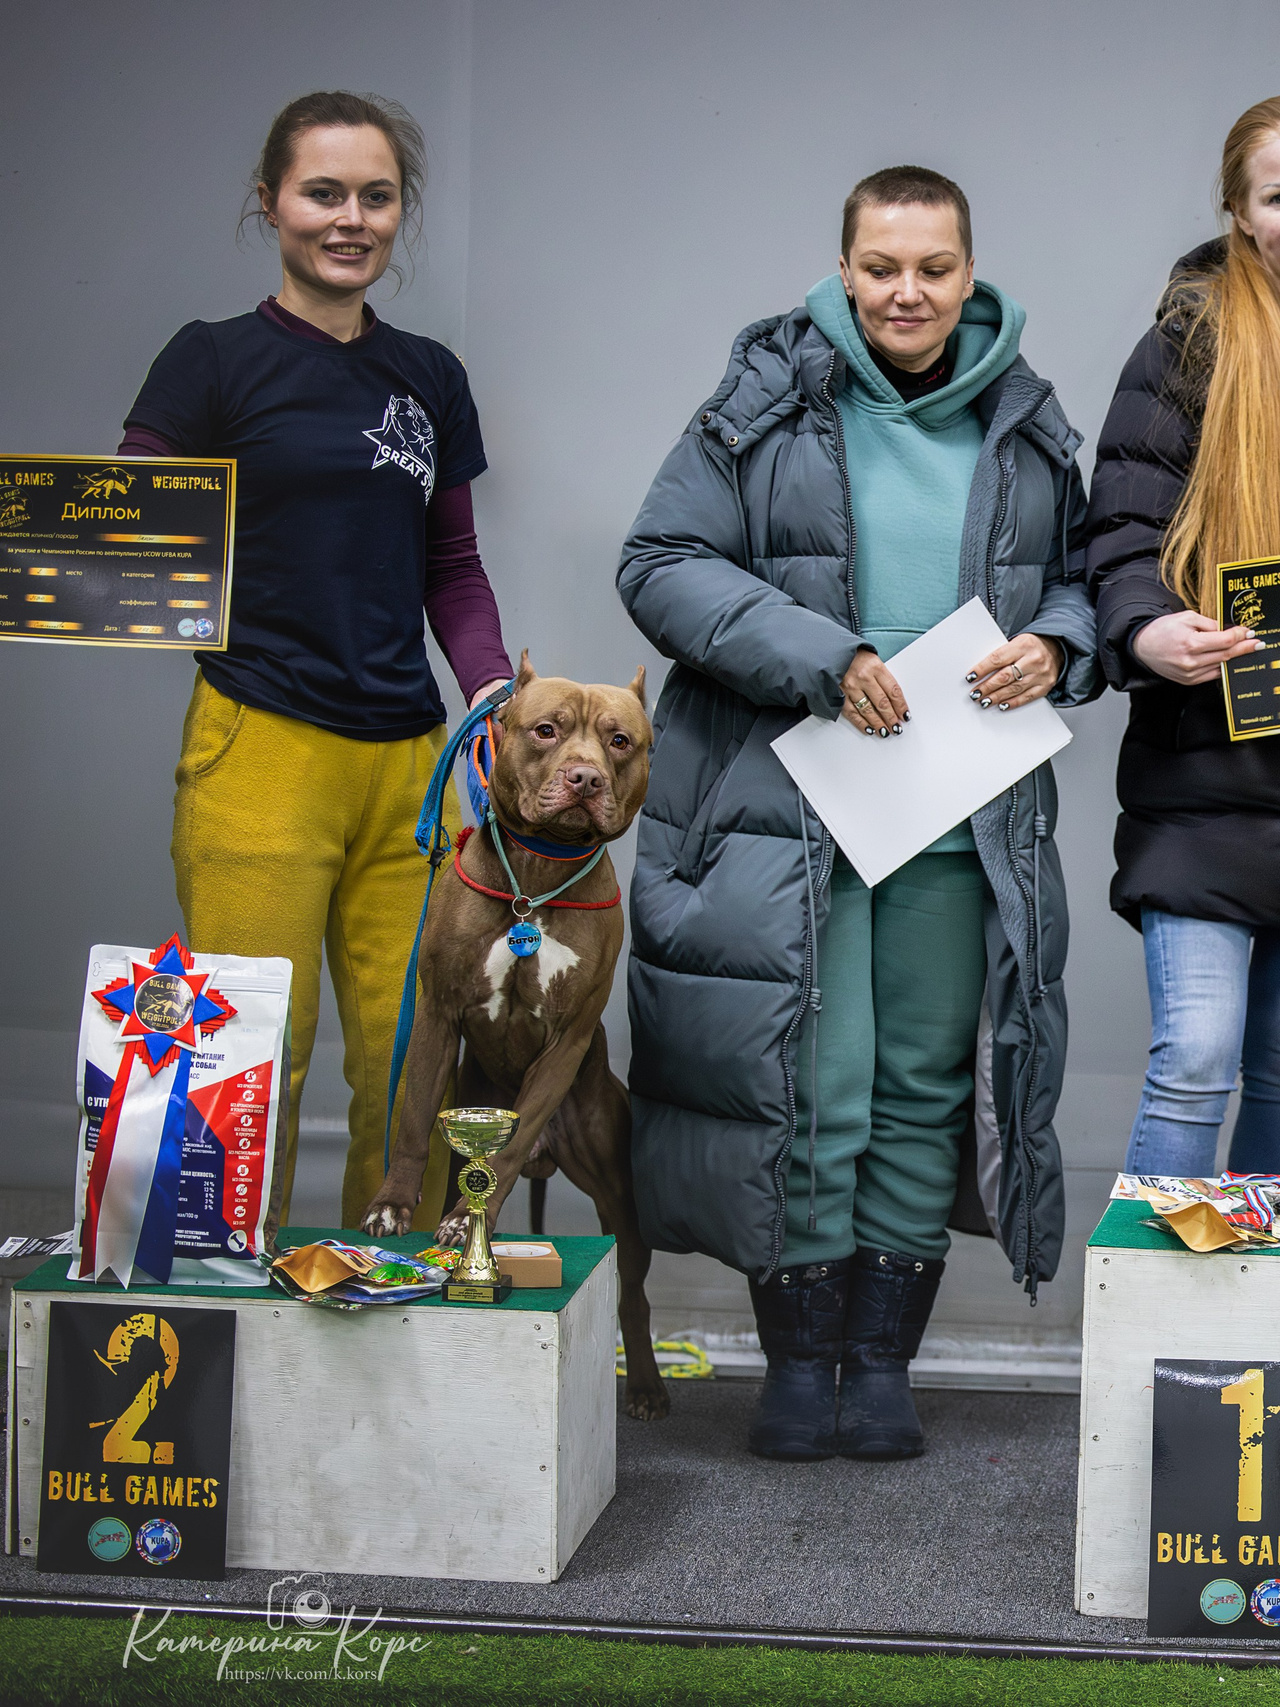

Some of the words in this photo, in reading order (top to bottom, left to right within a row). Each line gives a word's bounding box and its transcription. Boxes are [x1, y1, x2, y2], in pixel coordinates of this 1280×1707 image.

[380, 444, 423, 478] GREAT
[15, 472, 55, 486] GAMES
[152, 475, 222, 490] WEIGHTPULL
[61, 502, 141, 521] Диплом
[1228, 577, 1251, 592] BULL
[508, 934, 540, 945] Батон
[149, 979, 164, 988] BULL
[166, 981, 180, 990] GAM
[195, 1060, 217, 1070] СОБАК
[87, 1096, 93, 1107] С
[1221, 1368, 1265, 1522] 1
[48, 1470, 115, 1503] BULL
[125, 1474, 220, 1508] GAMES
[151, 1536, 169, 1545] KUPA
[1157, 1532, 1228, 1563] BULL
